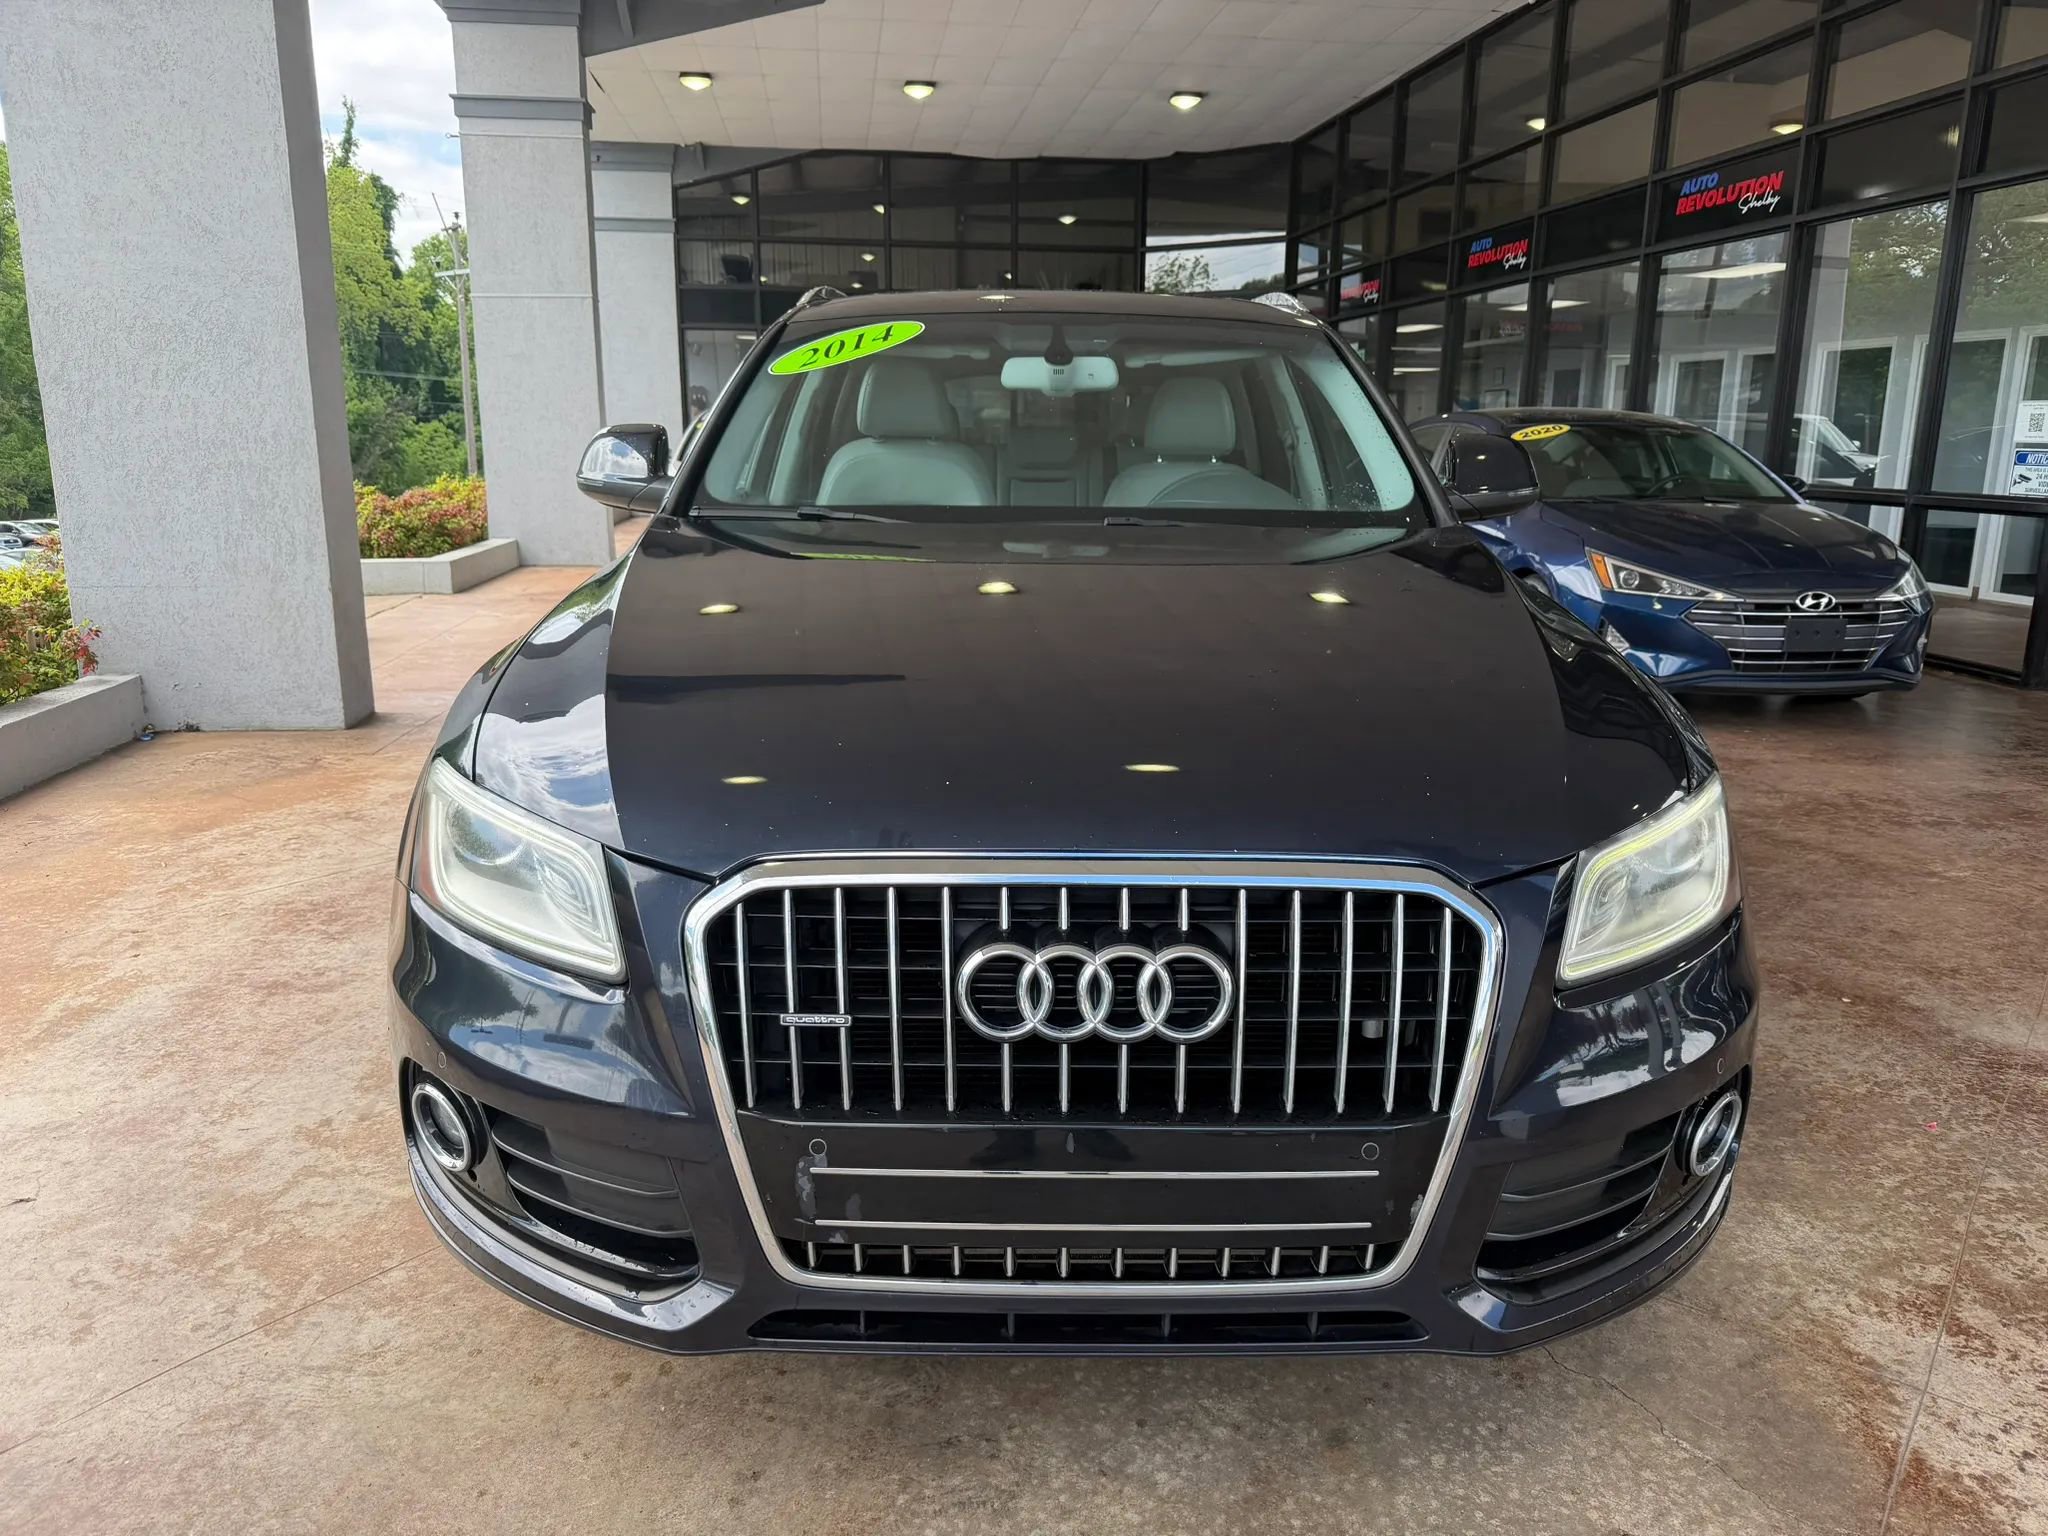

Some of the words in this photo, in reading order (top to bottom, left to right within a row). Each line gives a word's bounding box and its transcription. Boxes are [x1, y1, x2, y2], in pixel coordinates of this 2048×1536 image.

[1676, 170, 1785, 215] REVOLUTION
[1680, 172, 1720, 196] AUTO
[1738, 187, 1781, 214] Shelby
[1468, 238, 1529, 268] REVOLUTION
[1471, 237, 1493, 253] AUTO
[799, 324, 894, 369] 2014
[1519, 425, 1563, 439] 2020
[786, 1016, 845, 1024] quattro
